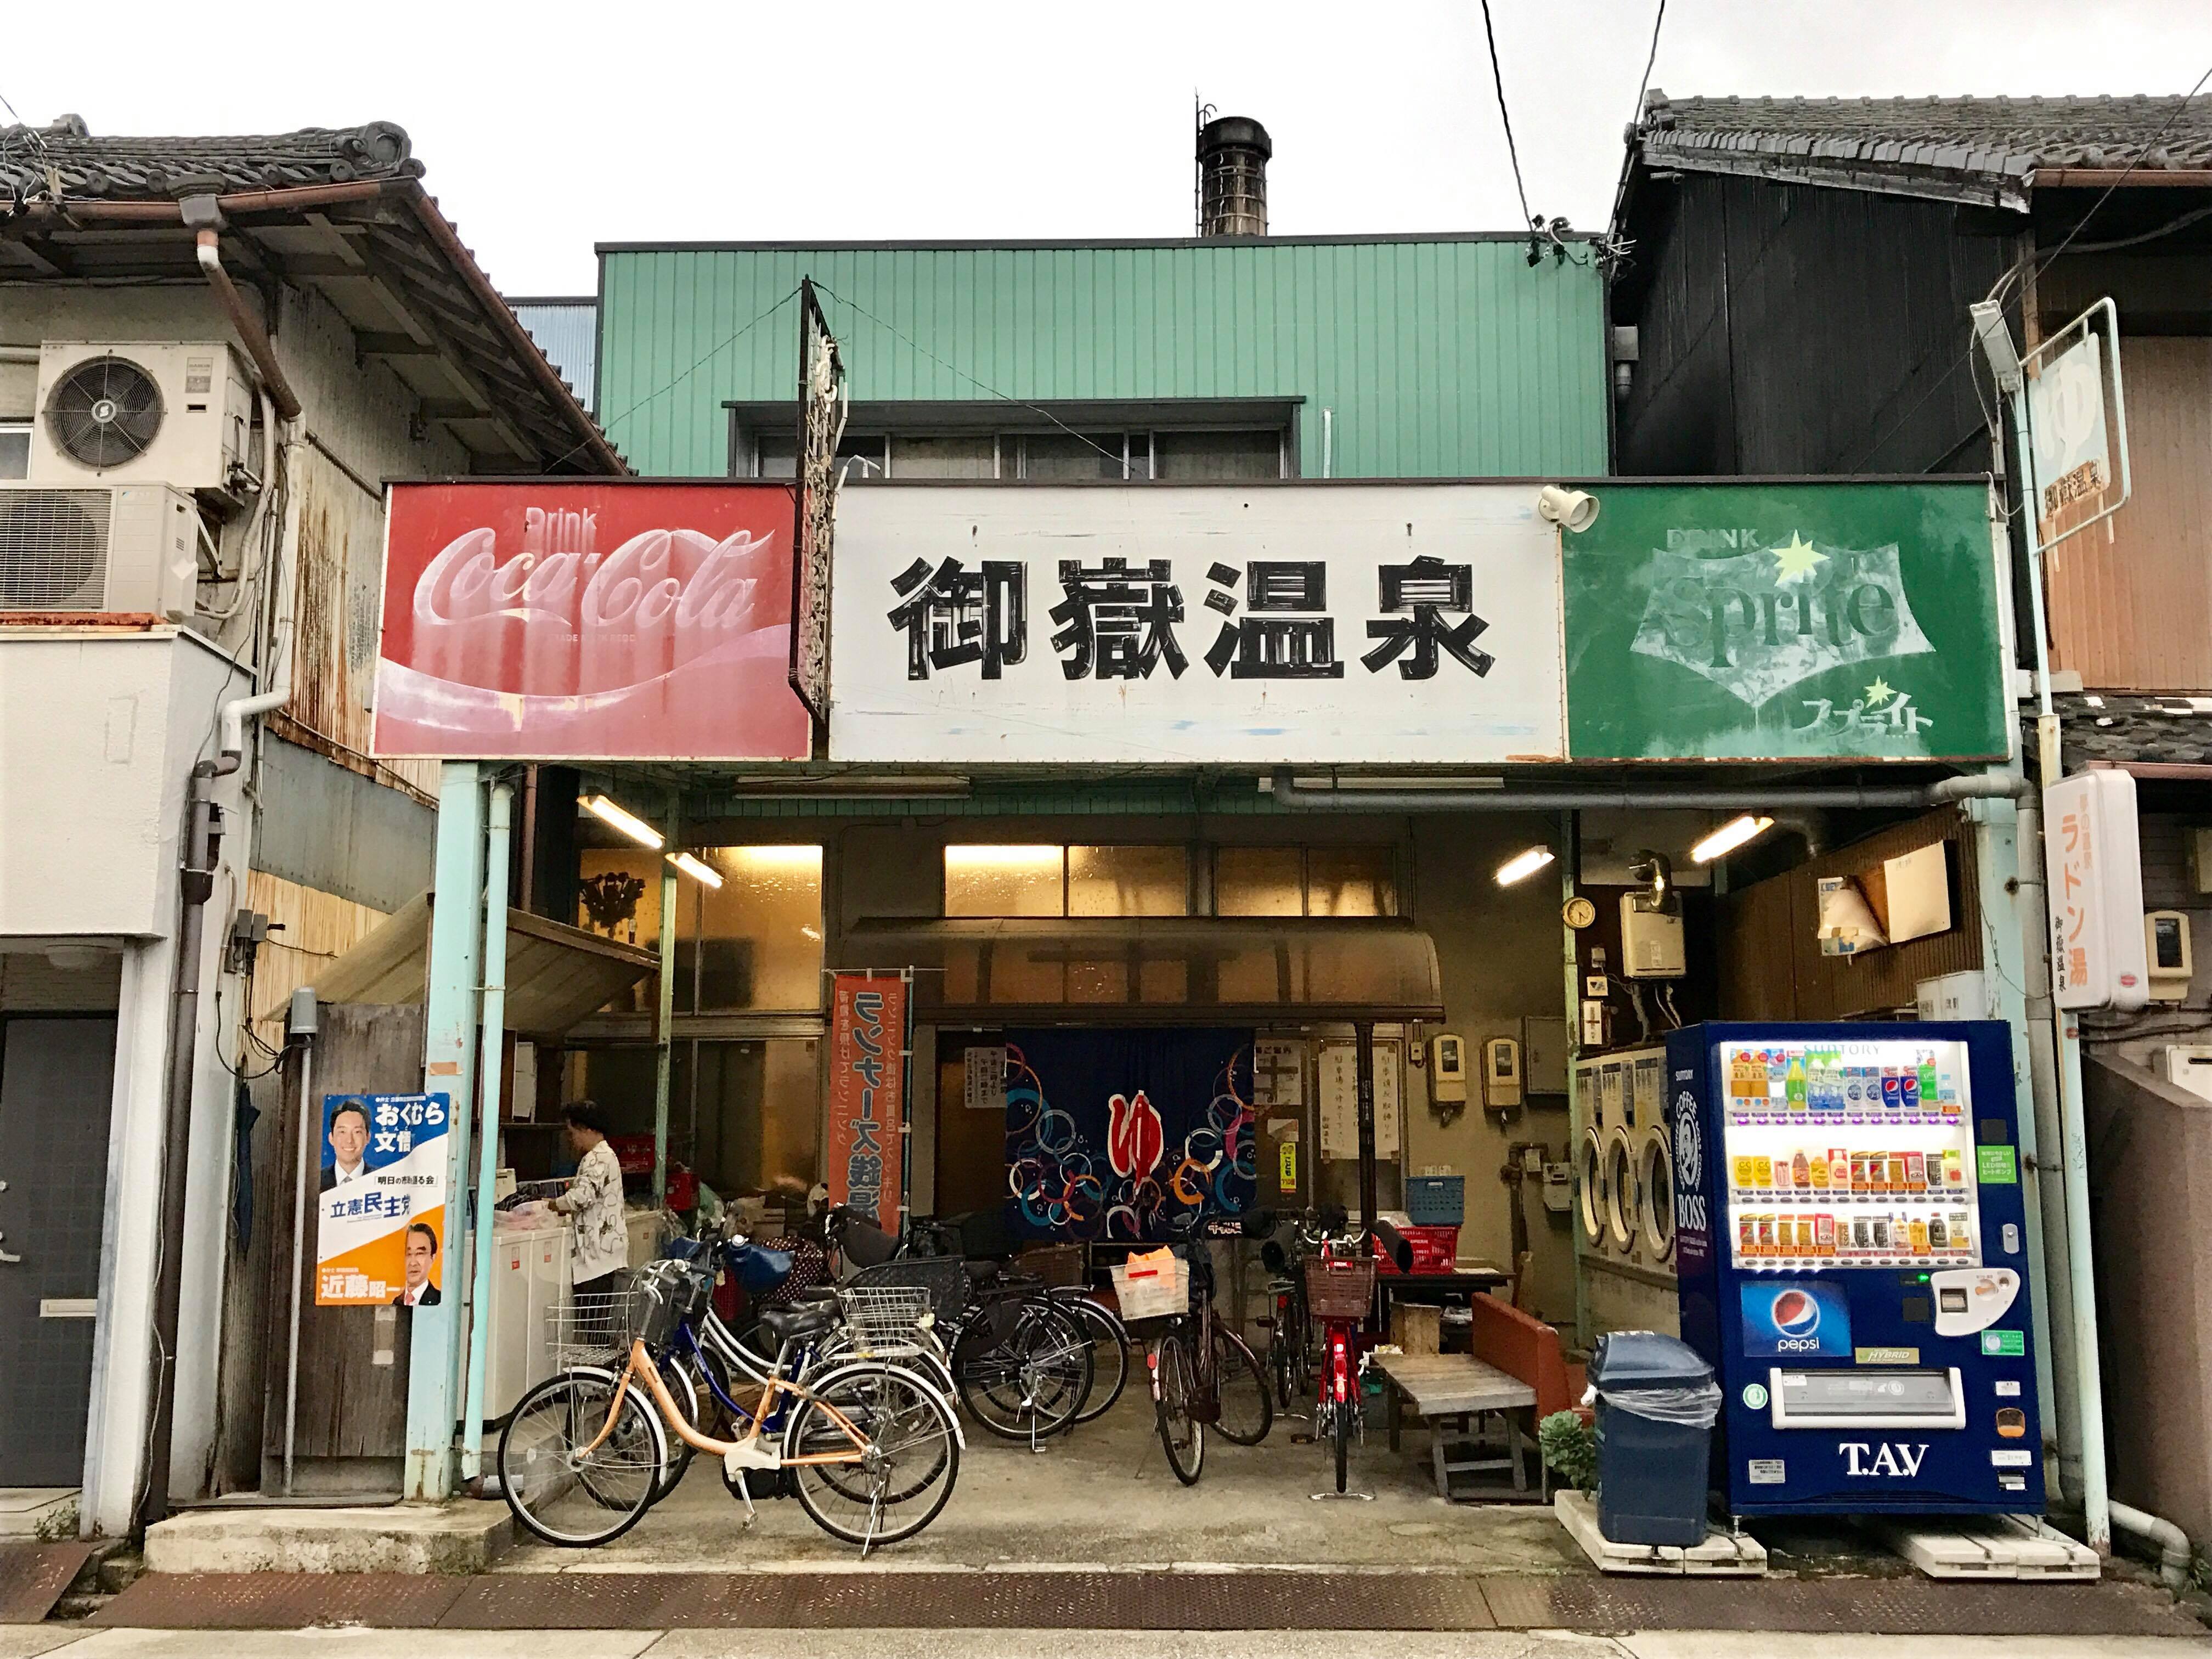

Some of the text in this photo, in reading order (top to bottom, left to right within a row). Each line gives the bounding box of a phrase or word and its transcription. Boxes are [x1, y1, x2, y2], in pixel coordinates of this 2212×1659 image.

[525, 507, 597, 532] Drink
[1667, 528, 1759, 549] DRINK
[413, 527, 776, 627] Coca-Cola
[887, 555, 1496, 681] 御嶽温泉
[1654, 573, 1896, 668] Sprite
[2061, 813, 2088, 986] ラドン湯
[1803, 1043, 1881, 1057] SUNTORY
[374, 1102, 445, 1127] おくむら
[1676, 1091, 1697, 1120] COFFEE
[1108, 1090, 1164, 1196] ゆ
[330, 1191, 411, 1220] 立憲民主党
[1678, 1193, 1706, 1232] BOSS
[321, 1274, 401, 1299] 近藤昭一
[1778, 1337, 1820, 1352] pepsi
[1868, 1350, 1910, 1362] HYBRID
[1838, 1442, 1929, 1478] T.A.V
